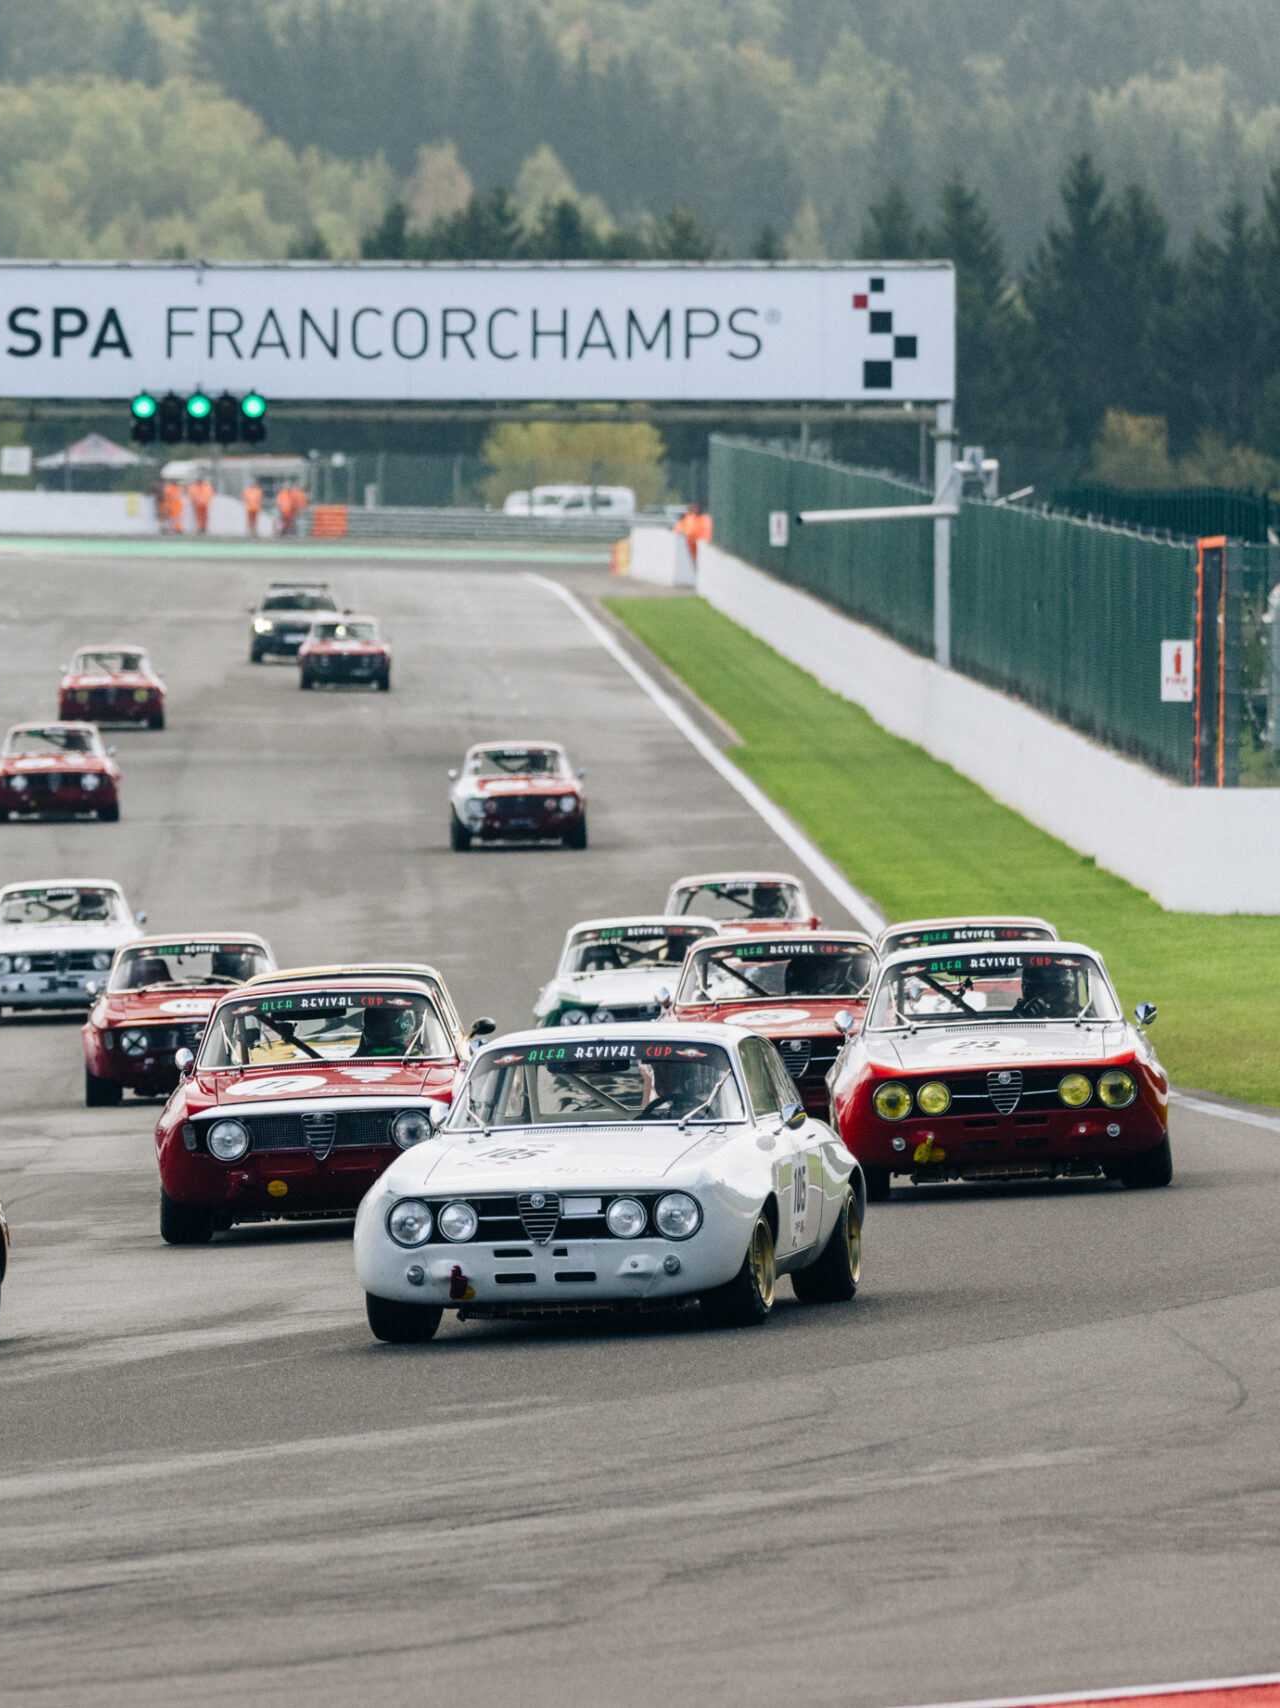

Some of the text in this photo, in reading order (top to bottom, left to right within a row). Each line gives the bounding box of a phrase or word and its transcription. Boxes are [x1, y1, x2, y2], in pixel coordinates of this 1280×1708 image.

[6, 307, 132, 359] SPA
[165, 307, 764, 360] FRANCORCHAMPS
[931, 956, 1052, 971] ALFA REVIVAL CUP
[261, 995, 384, 1012] ALFA REVIVAL CUP
[952, 1040, 1001, 1049] 23
[527, 1045, 673, 1062] ALFA REVIVAL CUP
[474, 1147, 551, 1160] 105
